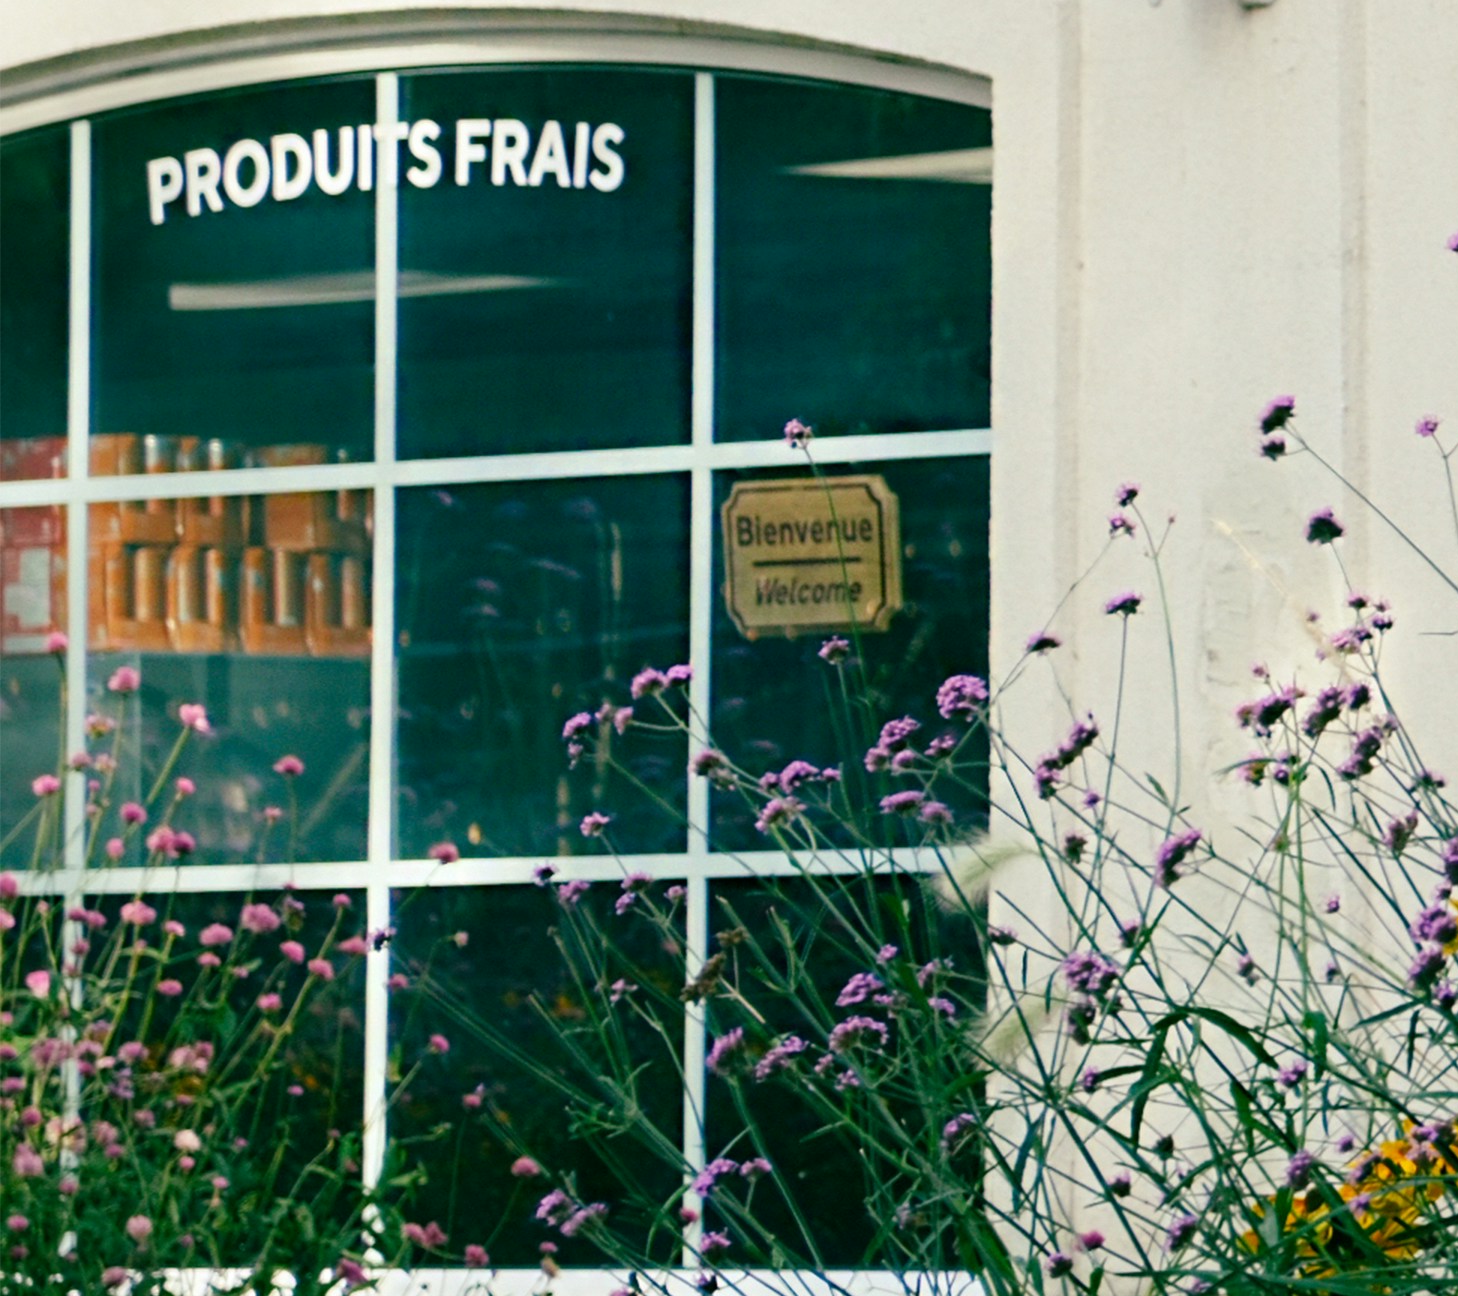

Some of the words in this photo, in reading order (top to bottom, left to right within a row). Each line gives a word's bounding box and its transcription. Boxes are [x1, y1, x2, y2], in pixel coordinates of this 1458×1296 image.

[147, 119, 441, 225] PRODUITS
[455, 119, 625, 192] FRAIS
[736, 515, 873, 547] Bienvenue
[755, 577, 862, 605] Welcome
